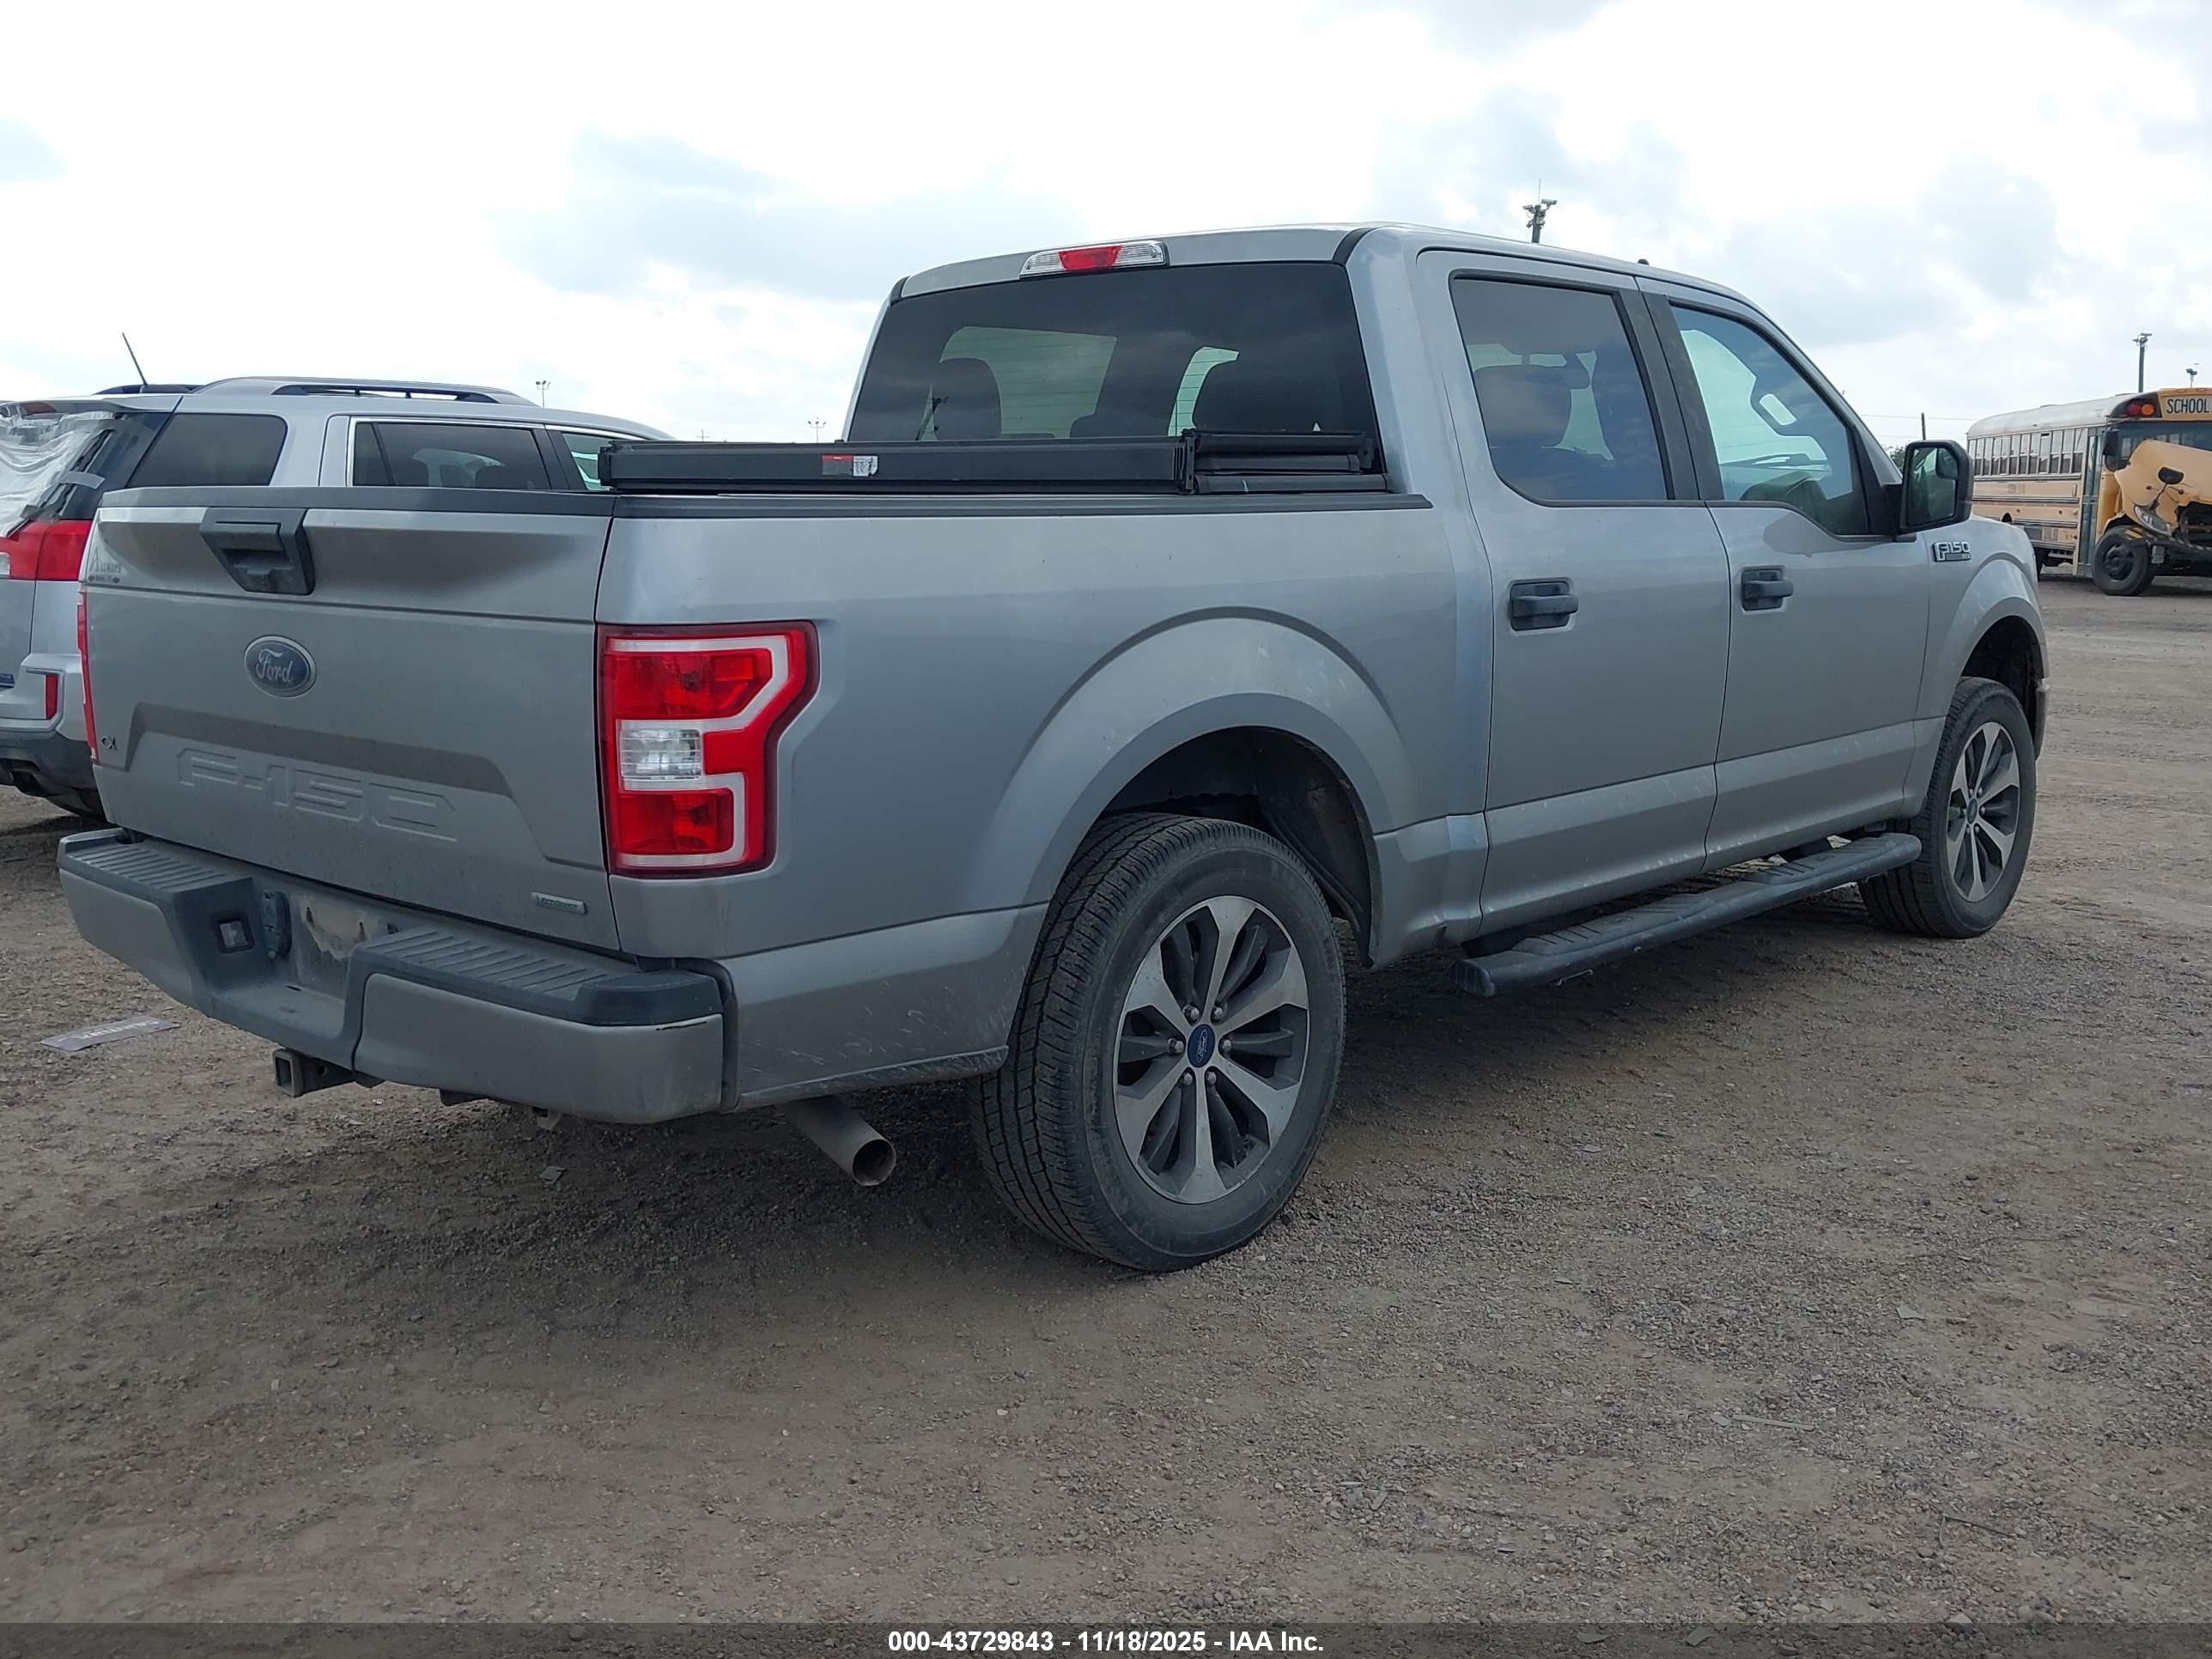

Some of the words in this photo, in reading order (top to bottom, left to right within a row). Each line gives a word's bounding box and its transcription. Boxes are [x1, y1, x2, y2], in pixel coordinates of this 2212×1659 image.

[2166, 398, 2210, 414] SCHOOL
[255, 648, 294, 684] Ford
[178, 747, 459, 842] F-150
